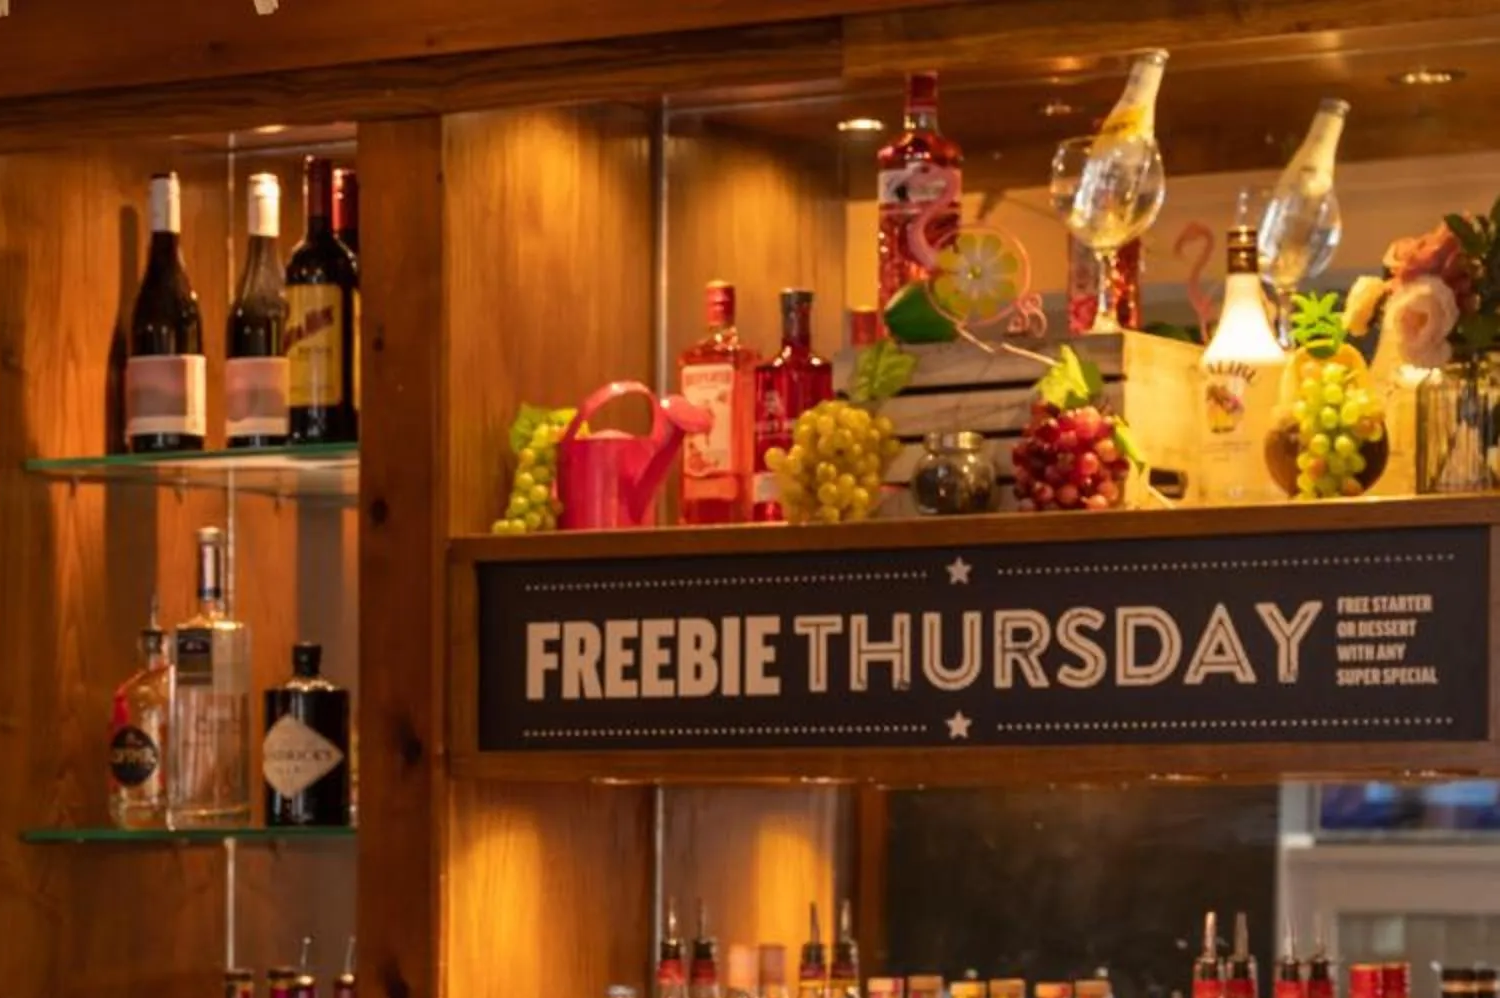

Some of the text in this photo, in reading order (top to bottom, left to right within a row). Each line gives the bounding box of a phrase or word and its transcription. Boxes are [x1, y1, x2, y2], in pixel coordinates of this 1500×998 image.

[1337, 593, 1433, 614] FREE STARTER
[1336, 618, 1417, 638] OR DESSERT
[526, 601, 1322, 700] FREEBIE THURSDAY
[1336, 641, 1407, 662] WITH ANY
[1336, 665, 1438, 687] SUPER SPECIAL
